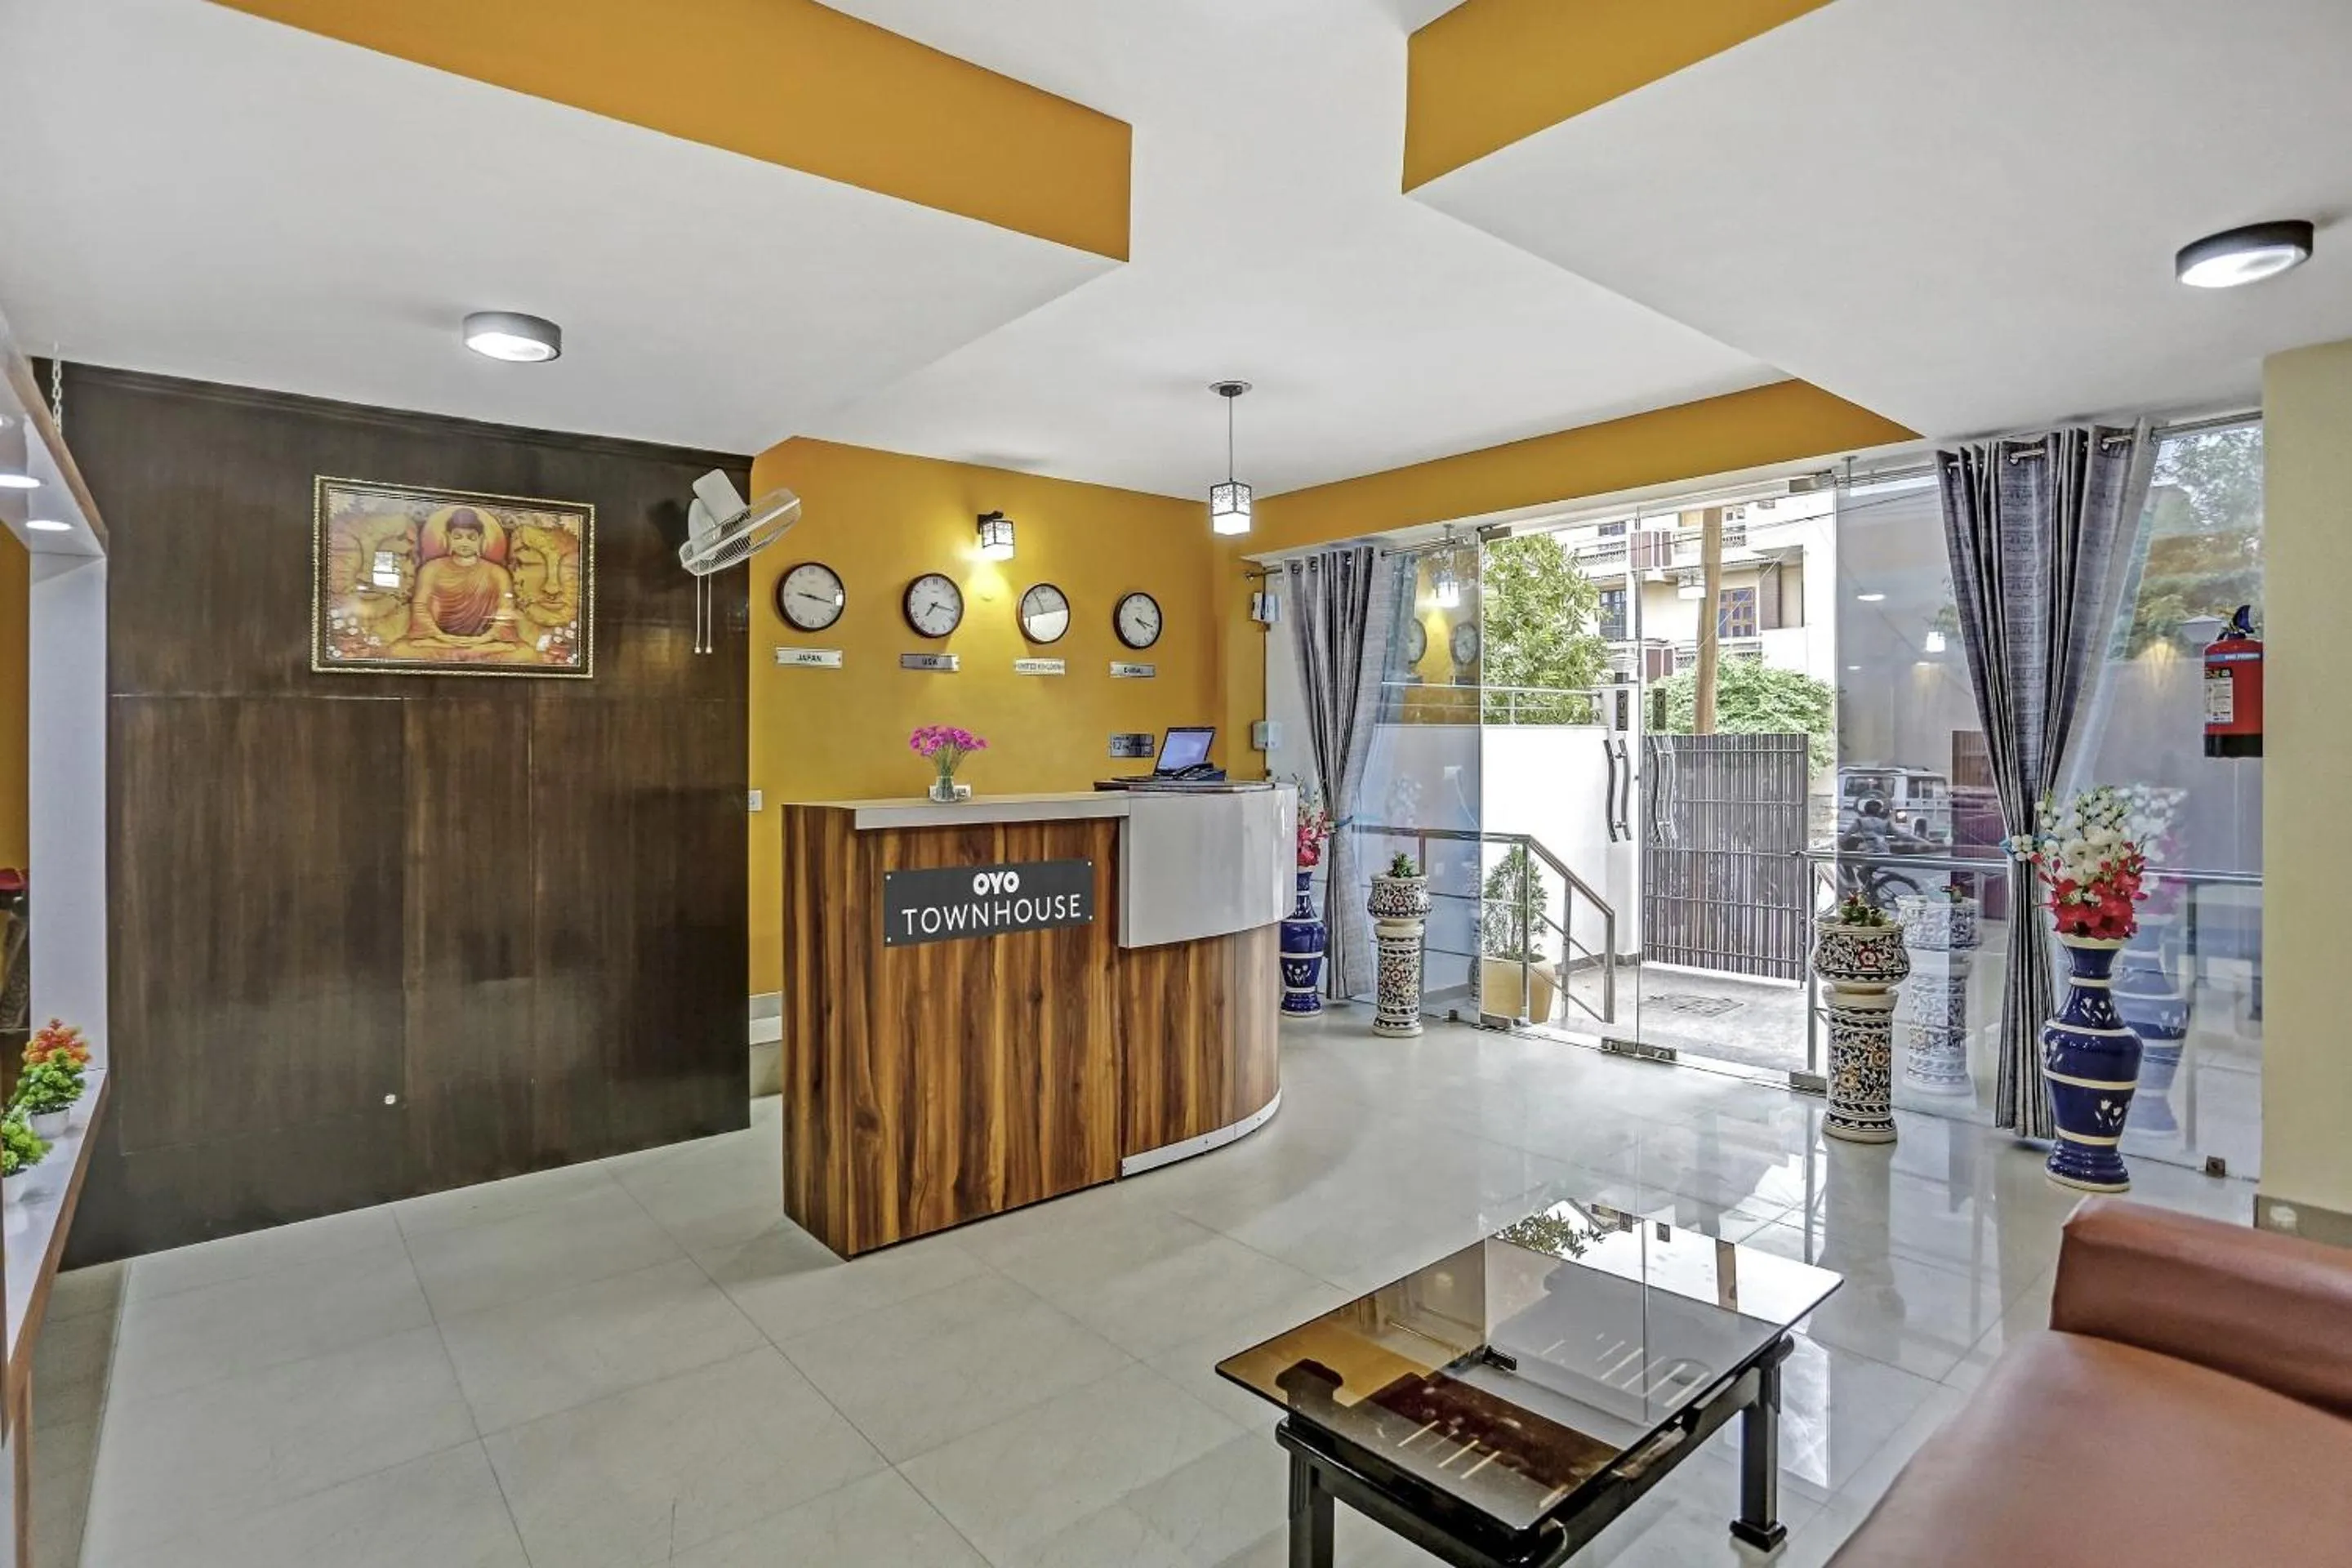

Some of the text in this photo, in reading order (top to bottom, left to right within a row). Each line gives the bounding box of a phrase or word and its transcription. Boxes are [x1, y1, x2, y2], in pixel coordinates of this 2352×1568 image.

[796, 653, 822, 662] JAPAN
[921, 657, 938, 666] USA
[973, 871, 1020, 896] OYO
[902, 893, 1081, 935] TOWNHOUSE
